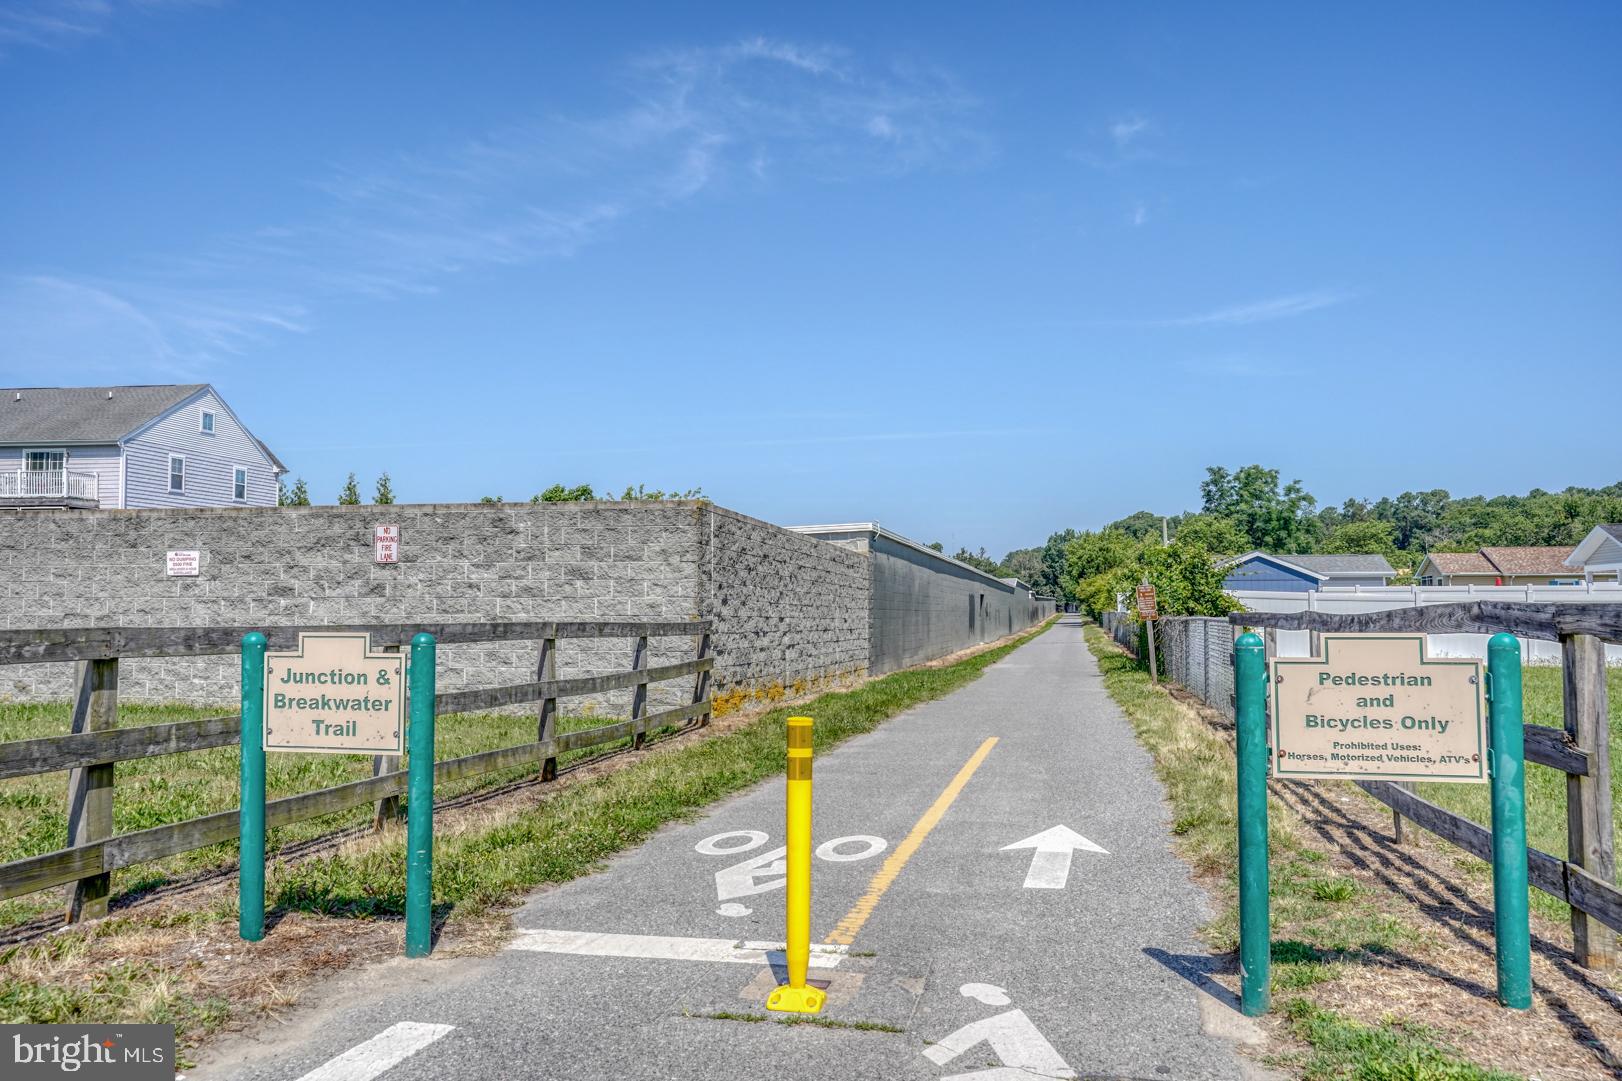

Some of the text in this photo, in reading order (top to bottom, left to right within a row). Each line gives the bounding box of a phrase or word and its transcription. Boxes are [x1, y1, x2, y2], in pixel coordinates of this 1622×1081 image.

[377, 535, 398, 544] PARKING
[380, 553, 393, 561] LANE
[280, 668, 391, 686] Junction &
[1318, 672, 1433, 687] Pedestrian
[273, 693, 393, 712] Breakwater
[1356, 694, 1395, 708] and
[311, 719, 357, 737] Trail
[1304, 714, 1450, 734] Bicycles Only
[1332, 741, 1422, 752] Prohibited Uses:
[1287, 751, 1471, 765] Horses, Motorized Vehicles, ATV's
